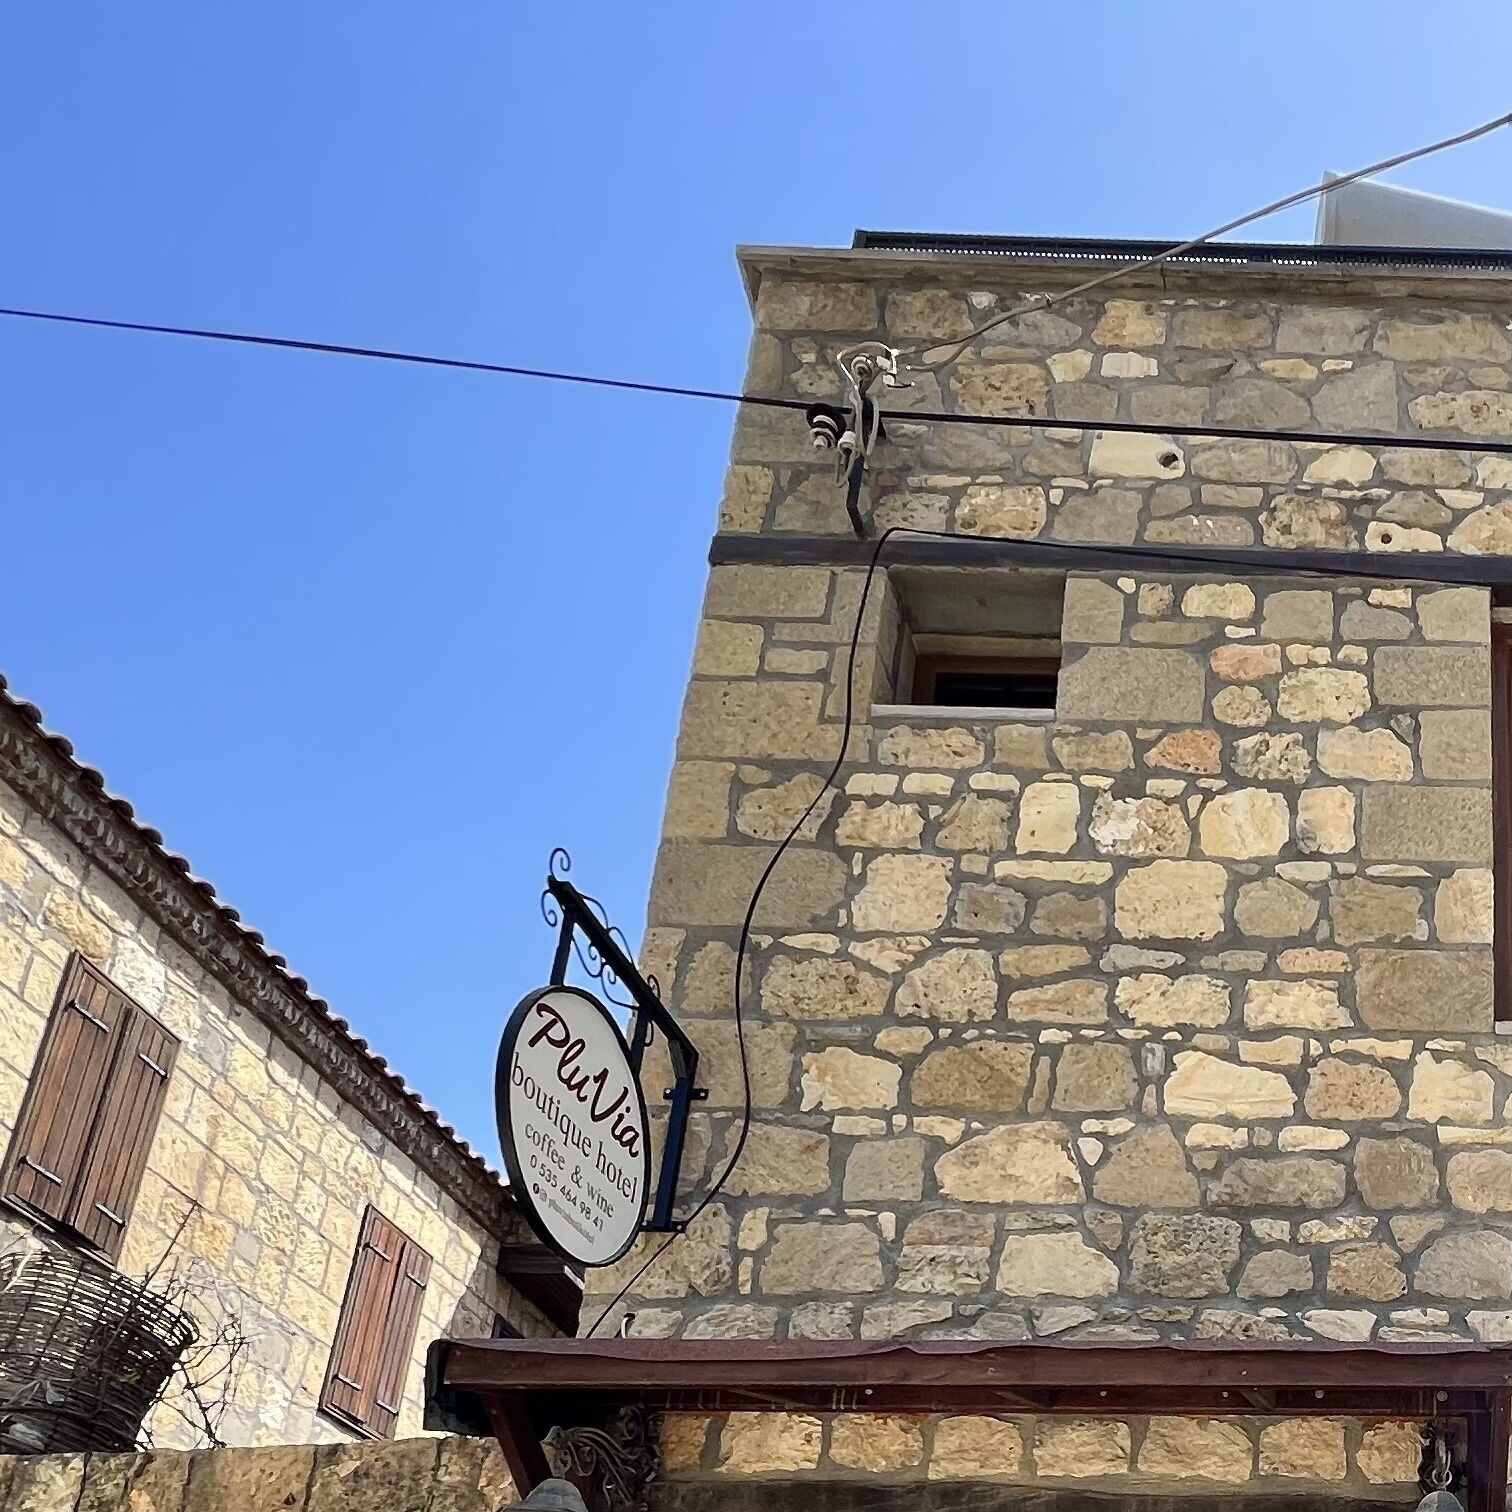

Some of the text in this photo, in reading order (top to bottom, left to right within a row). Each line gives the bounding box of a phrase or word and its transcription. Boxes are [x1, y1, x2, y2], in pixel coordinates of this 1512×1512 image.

[511, 1051, 593, 1159] boutique
[595, 1140, 639, 1205] hotel
[524, 1121, 615, 1218] coffee & wine
[530, 1154, 538, 1169] 0
[539, 1163, 558, 1188] 535
[559, 1184, 578, 1207] 464
[579, 1201, 592, 1221] 98
